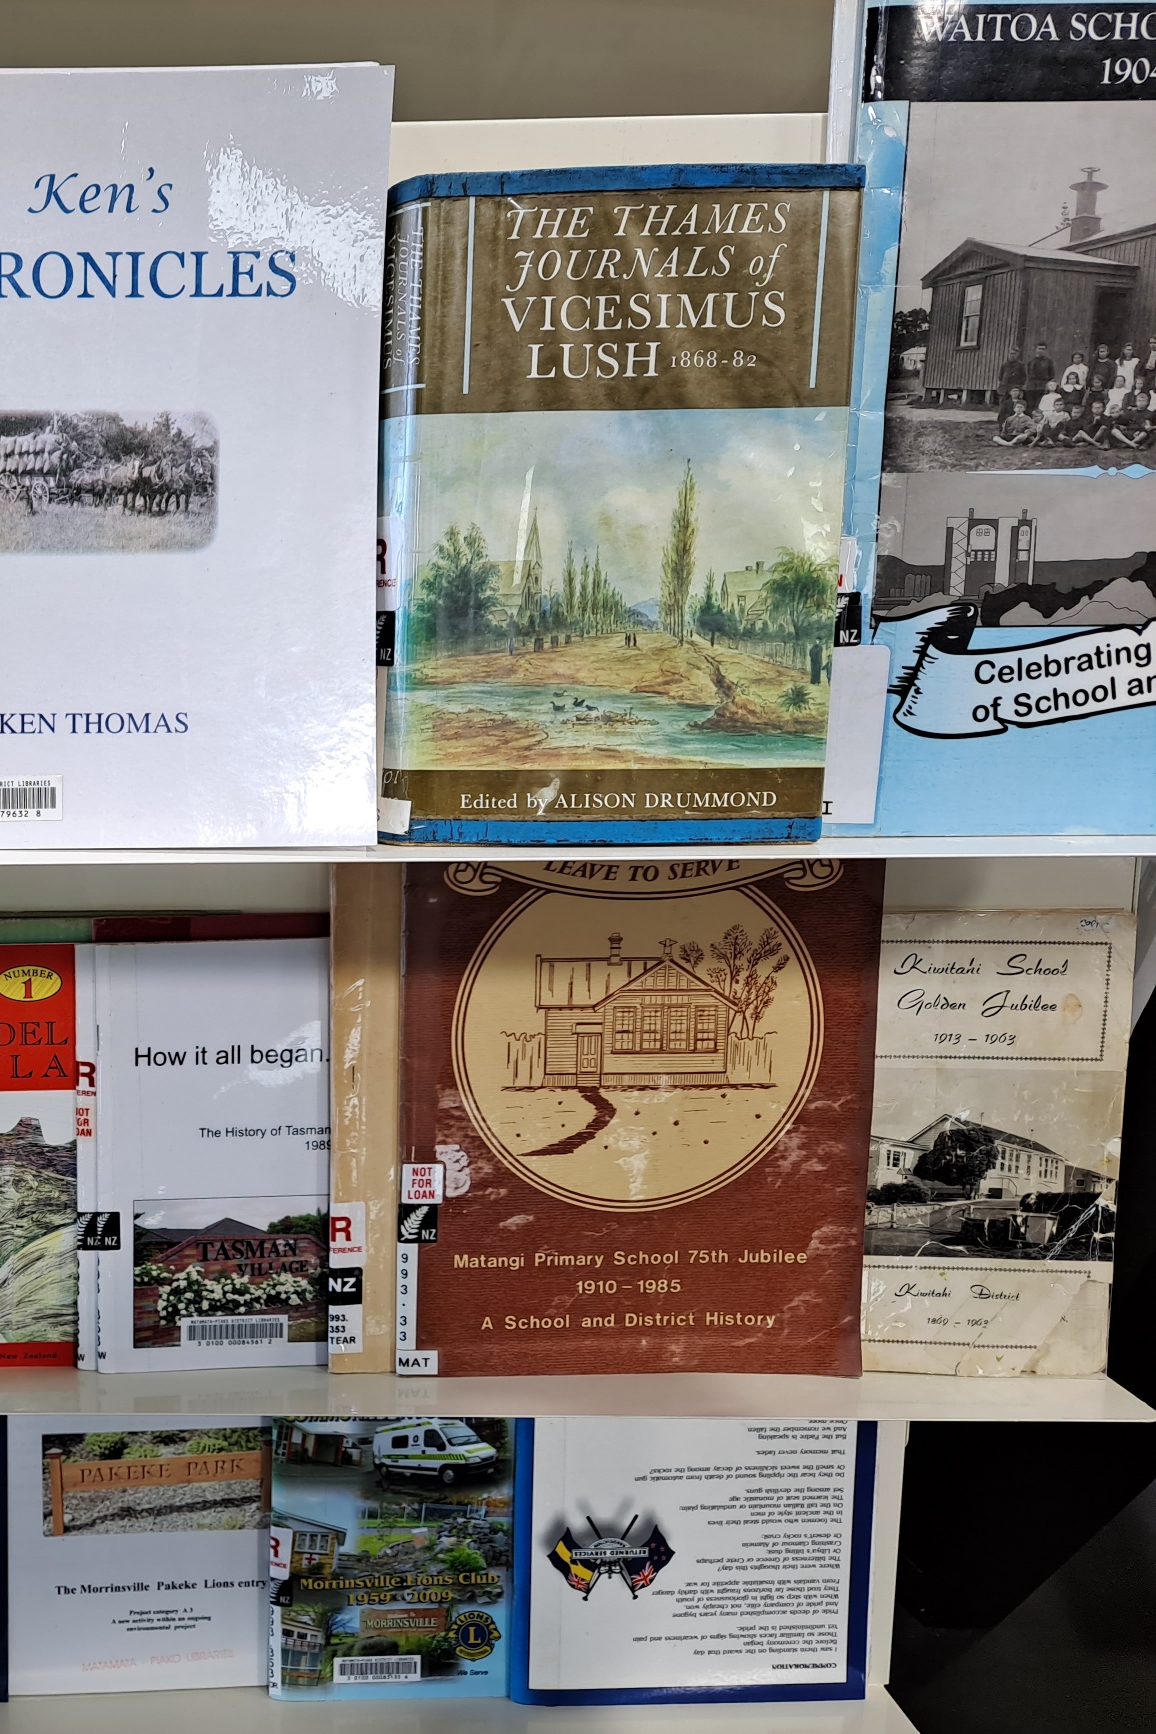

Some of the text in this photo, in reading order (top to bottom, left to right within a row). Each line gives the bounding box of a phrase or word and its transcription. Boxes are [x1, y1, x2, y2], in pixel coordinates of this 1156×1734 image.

[917, 13, 1061, 42] WAITOA
[27, 167, 173, 214] Ken's
[507, 202, 792, 241] THE THAMES
[505, 243, 787, 292] JOURNALS of
[501, 290, 787, 332] VICESIMUS
[526, 342, 757, 379] LUSH 1868-82
[974, 642, 1152, 685] Celebrating
[972, 677, 1117, 722] of School
[65, 712, 189, 734] THOMAS
[460, 791, 778, 815] Edited by ALISON DRUMMOND
[543, 860, 741, 882] LEAVE TO SERVE
[4, 969, 54, 981] NUMBER
[894, 953, 1069, 976] Kiwitahi School
[21, 978, 34, 999] 1
[897, 988, 1058, 1018] Golden Jubilee
[934, 1032, 1017, 1046] 1913 1963
[134, 1047, 186, 1066] How
[195, 1046, 207, 1065] it
[215, 1045, 241, 1065] all
[199, 1125, 331, 1139] The History of Tasman
[412, 1167, 432, 1177] NOT
[411, 1179, 432, 1188] FOR
[408, 1190, 435, 1200] LOAN
[196, 1239, 298, 1262] TASMAN
[454, 1249, 808, 1271] Matangi Primary School 75th Jubilee
[236, 1260, 308, 1277] VILLAGE
[576, 1279, 681, 1295] 1910 1985
[894, 1283, 1020, 1301] Kiwitahi District
[481, 1311, 776, 1330] A School and District History
[399, 1358, 430, 1367] MAT
[79, 1458, 245, 1484] PAKEKE PARK
[55, 1579, 267, 1595] The Morrinsville Pakeke Lions entry
[300, 1572, 499, 1590] Morrinsville Lions Club
[347, 1590, 453, 1606] 1959 2009
[365, 1618, 438, 1628] MORRINSVILLE
[459, 1612, 490, 1624] LIONS
